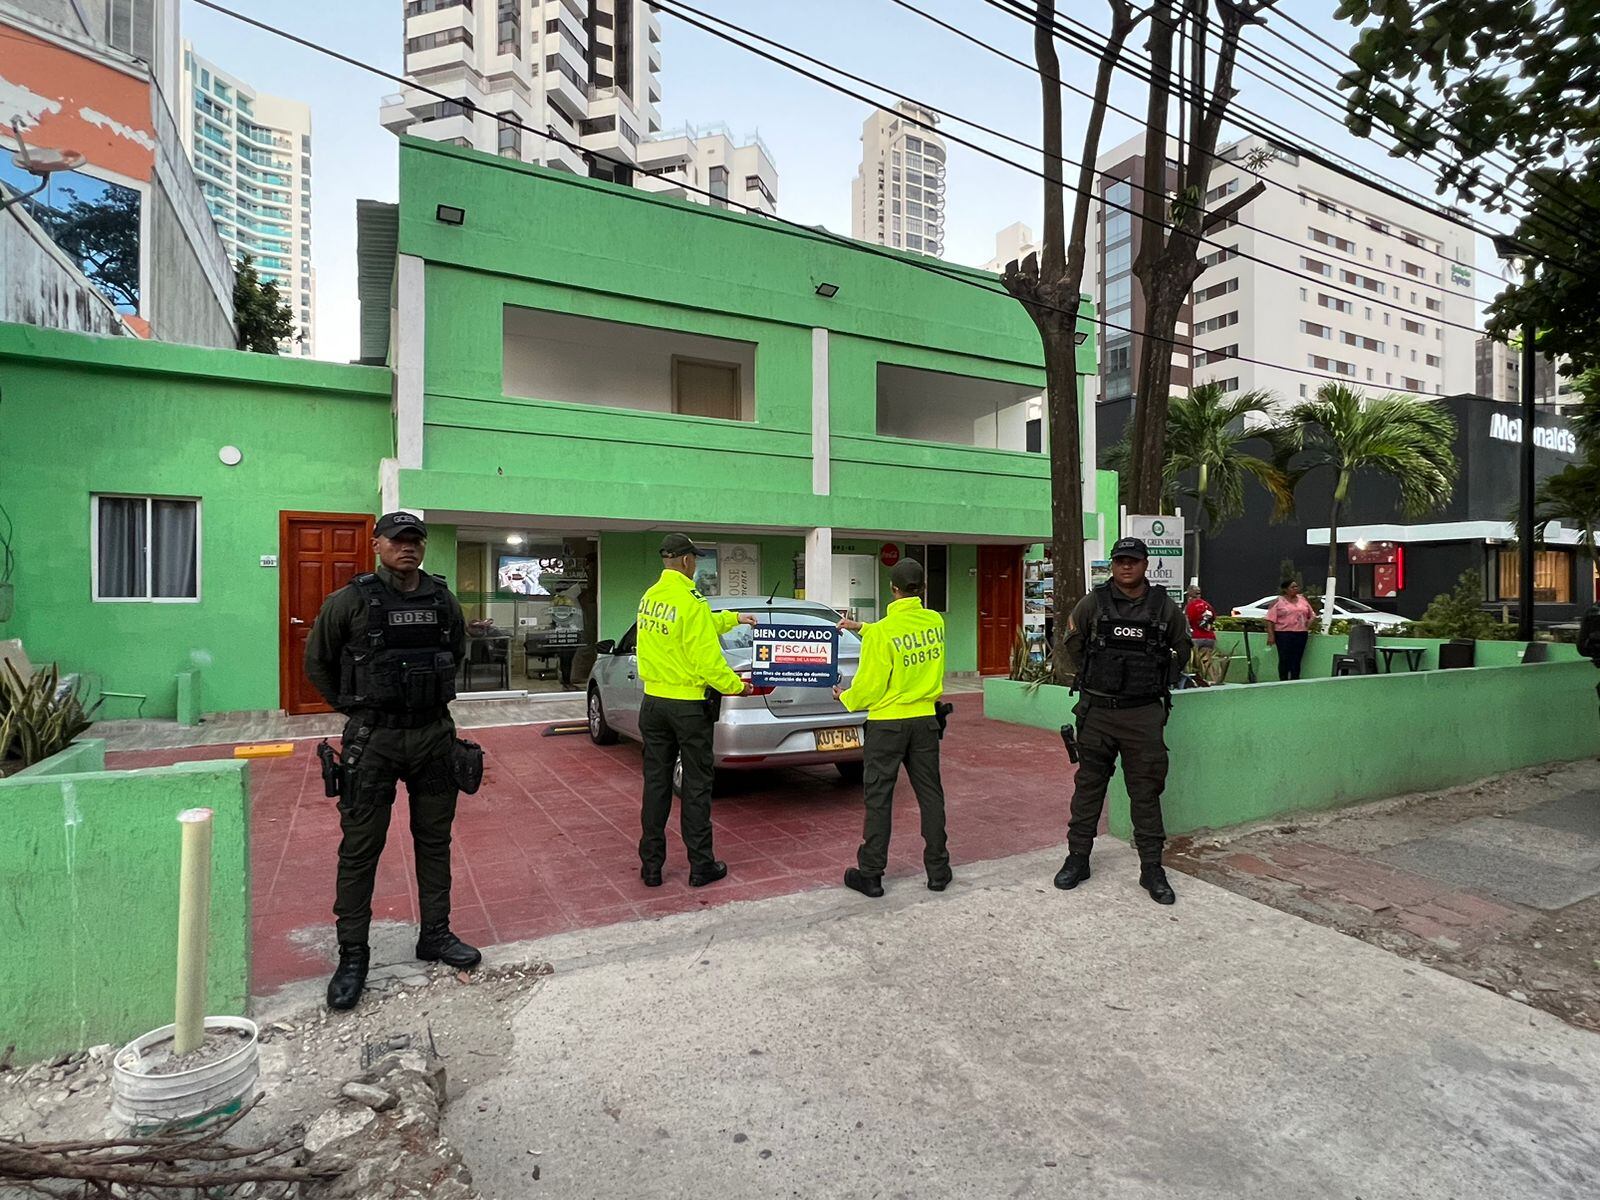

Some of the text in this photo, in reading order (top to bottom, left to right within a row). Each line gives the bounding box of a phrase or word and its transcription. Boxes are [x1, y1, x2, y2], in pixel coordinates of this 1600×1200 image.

[1489, 413, 1576, 454] Mcnald's
[729, 569, 740, 596] OUSE
[393, 612, 434, 623] GOES
[753, 629, 832, 640] BIEN OCUPADO
[1113, 627, 1143, 637] GOES
[775, 644, 827, 654] FISCALÍA
[903, 645, 943, 667] 60813
